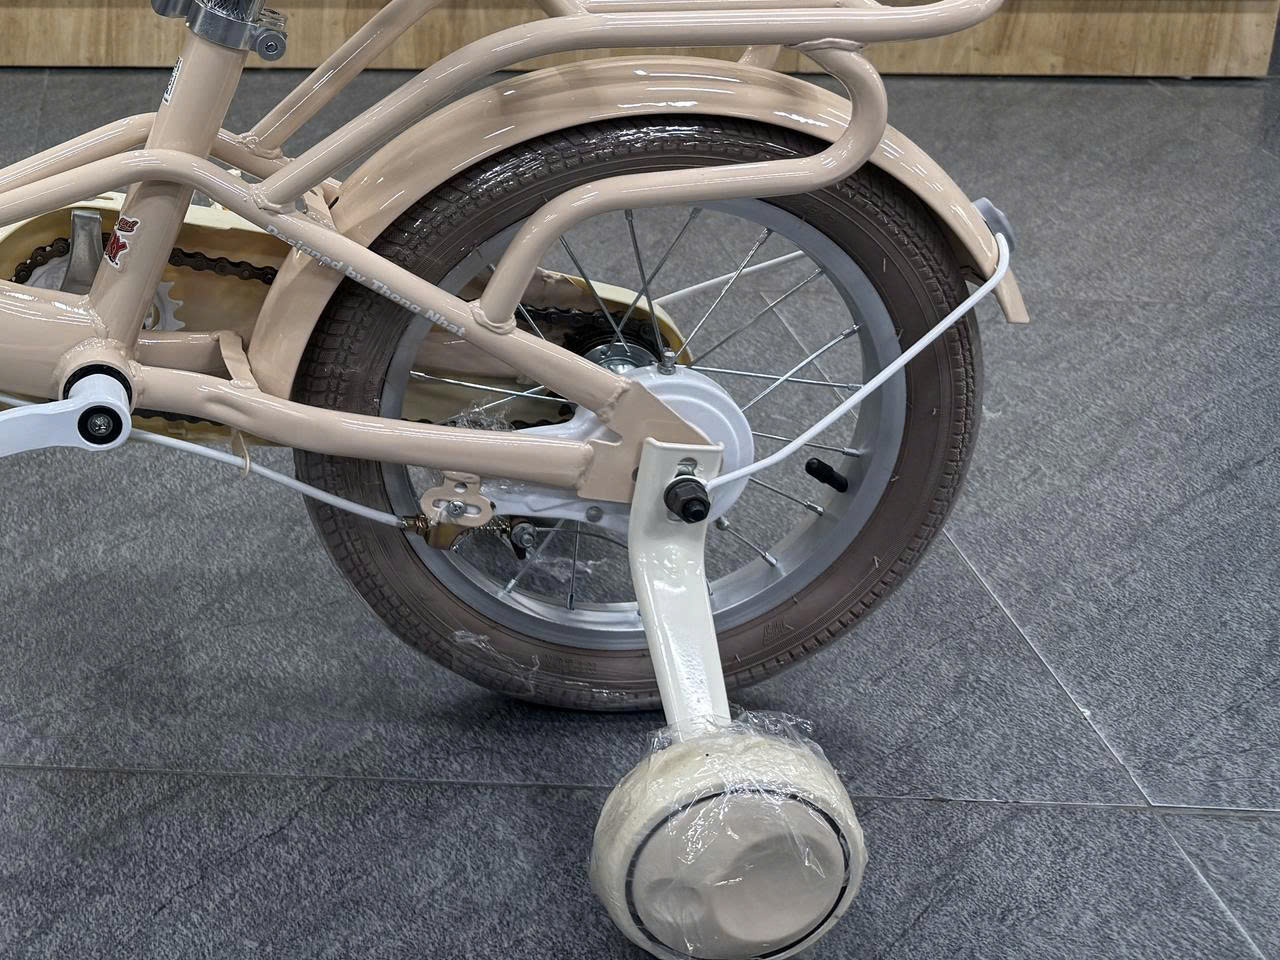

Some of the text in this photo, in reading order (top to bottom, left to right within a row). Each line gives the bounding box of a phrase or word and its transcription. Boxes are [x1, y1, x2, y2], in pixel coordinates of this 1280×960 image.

[266, 225, 466, 337] Designed by Thong Nhat
